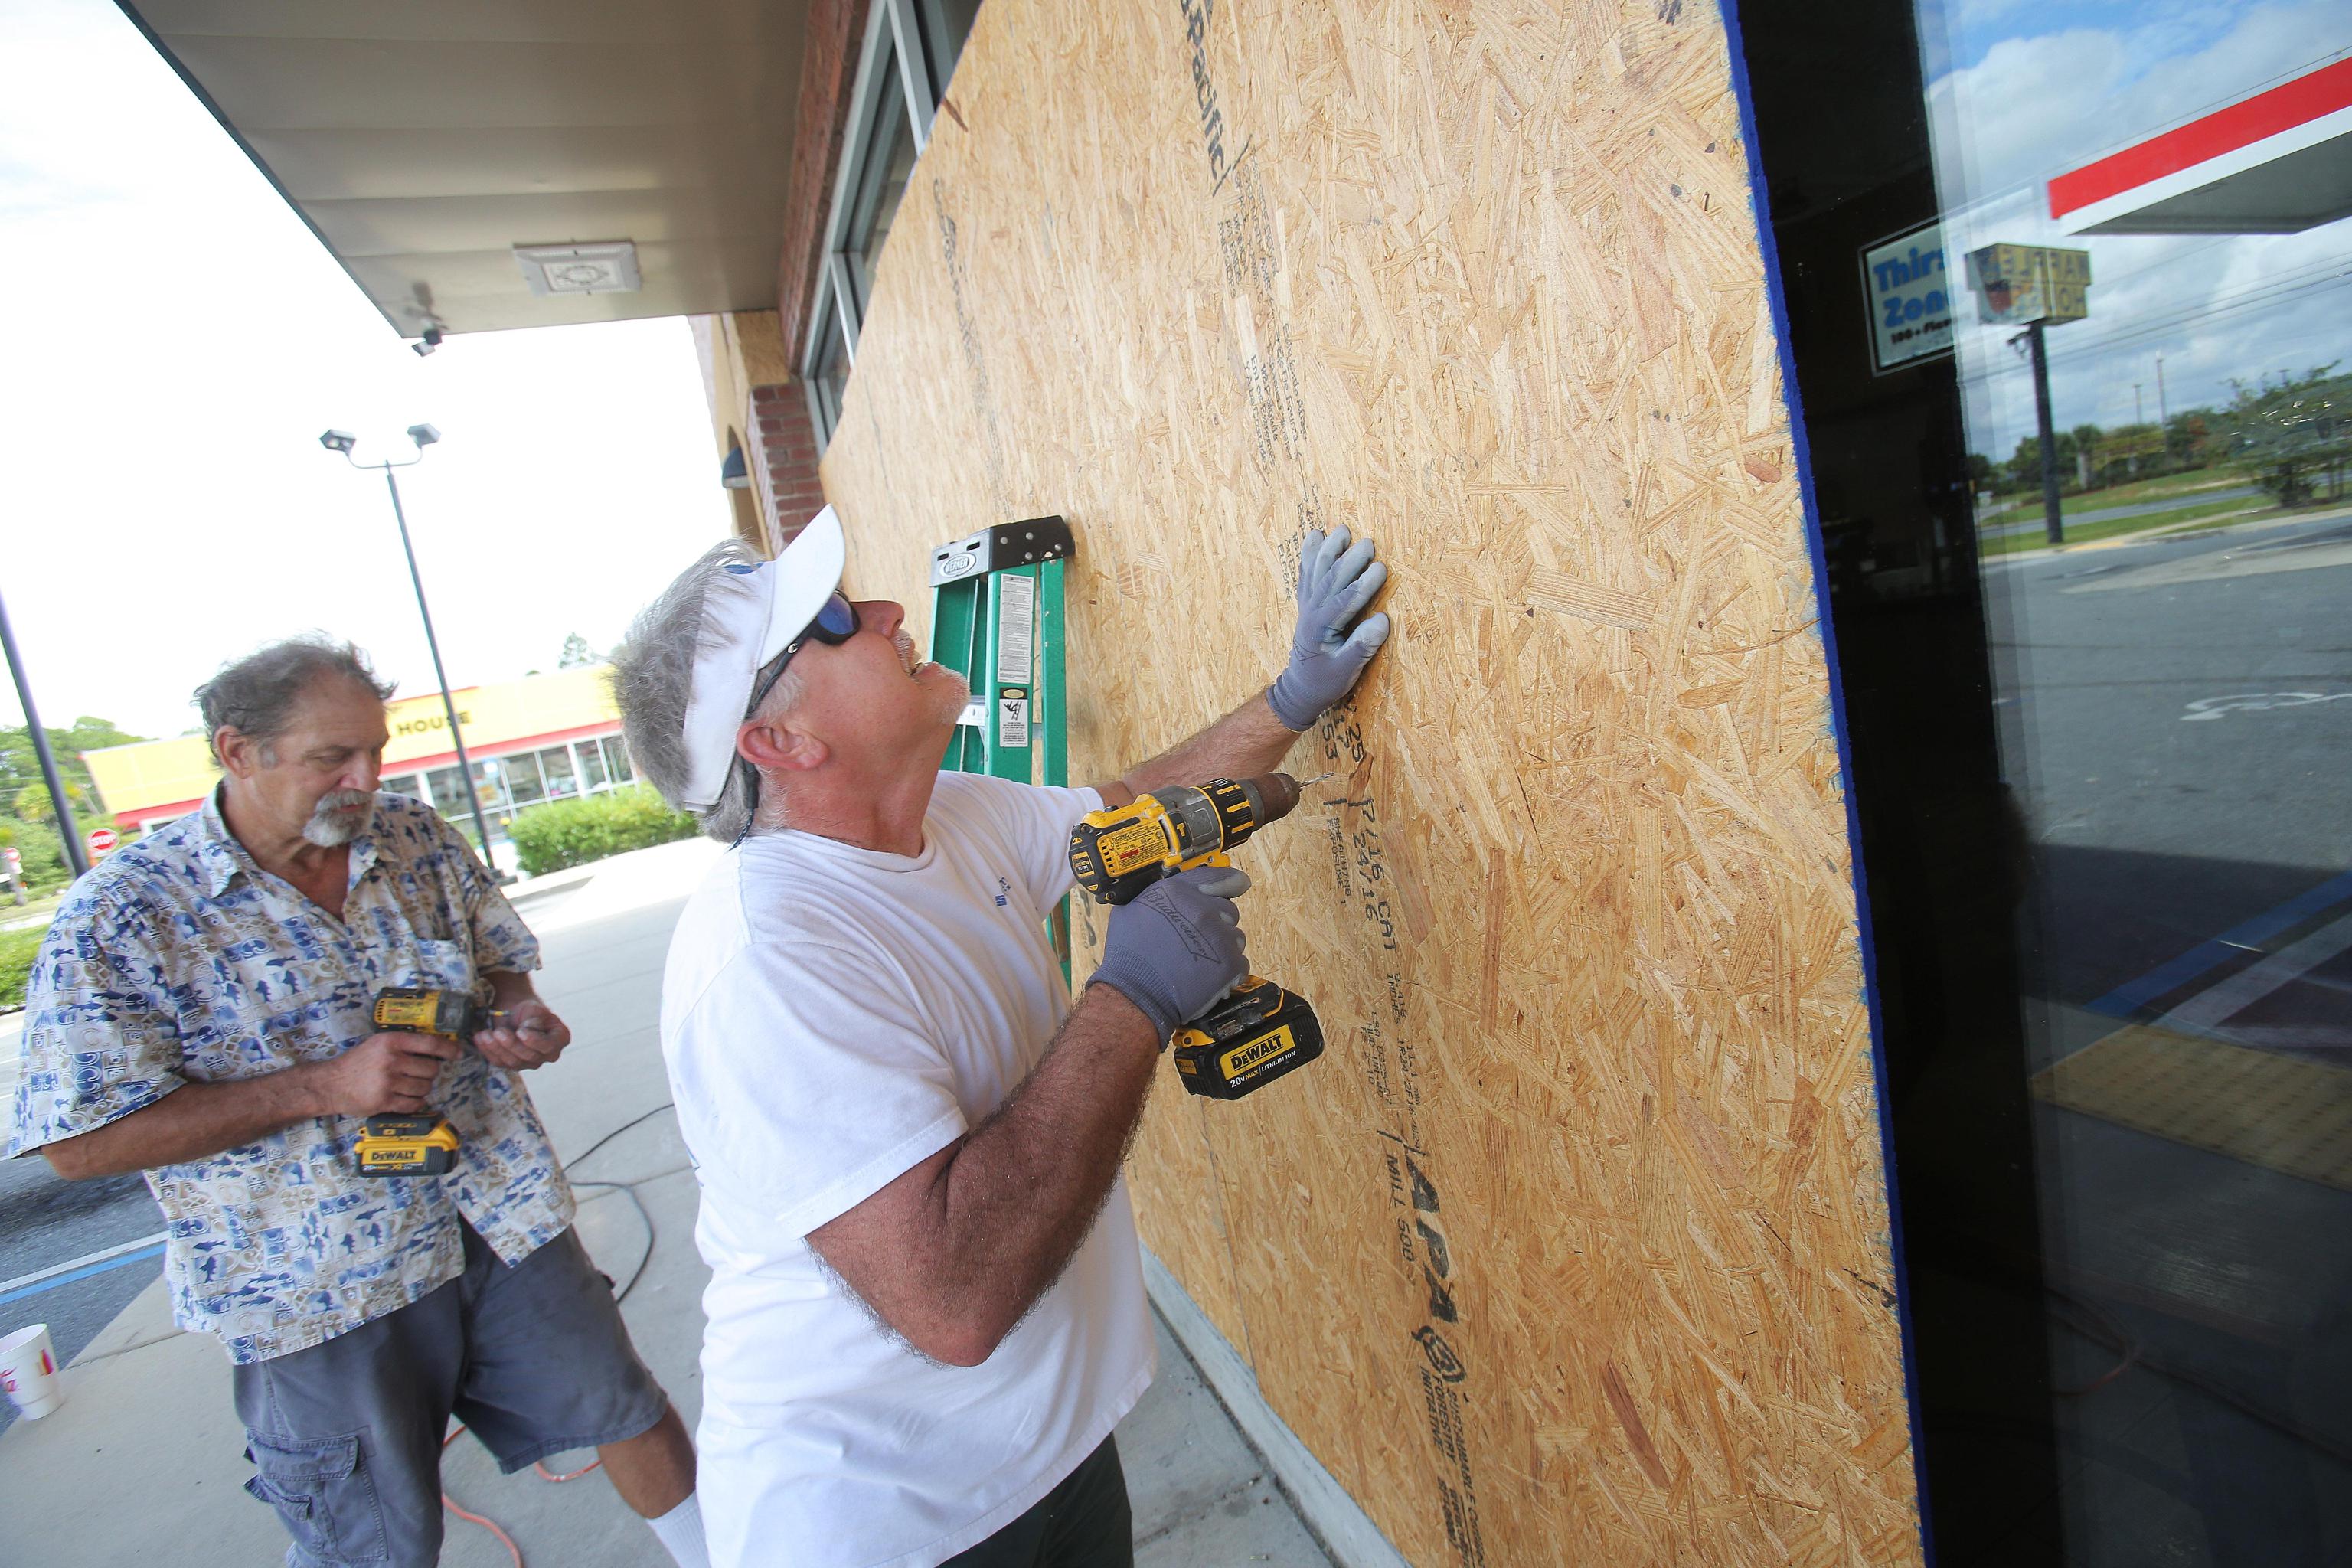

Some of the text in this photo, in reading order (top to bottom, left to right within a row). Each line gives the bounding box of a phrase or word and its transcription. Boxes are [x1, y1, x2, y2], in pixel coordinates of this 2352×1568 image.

[1883, 290, 1950, 328] Zon
[1352, 831, 1379, 921] 24/16
[1377, 901, 1397, 954] CAT
[1285, 1050, 1296, 1060] ION
[1387, 1154, 1408, 1212] MILL
[1407, 1156, 1458, 1324] APA
[1432, 1375, 1456, 1464] FORESTRY
